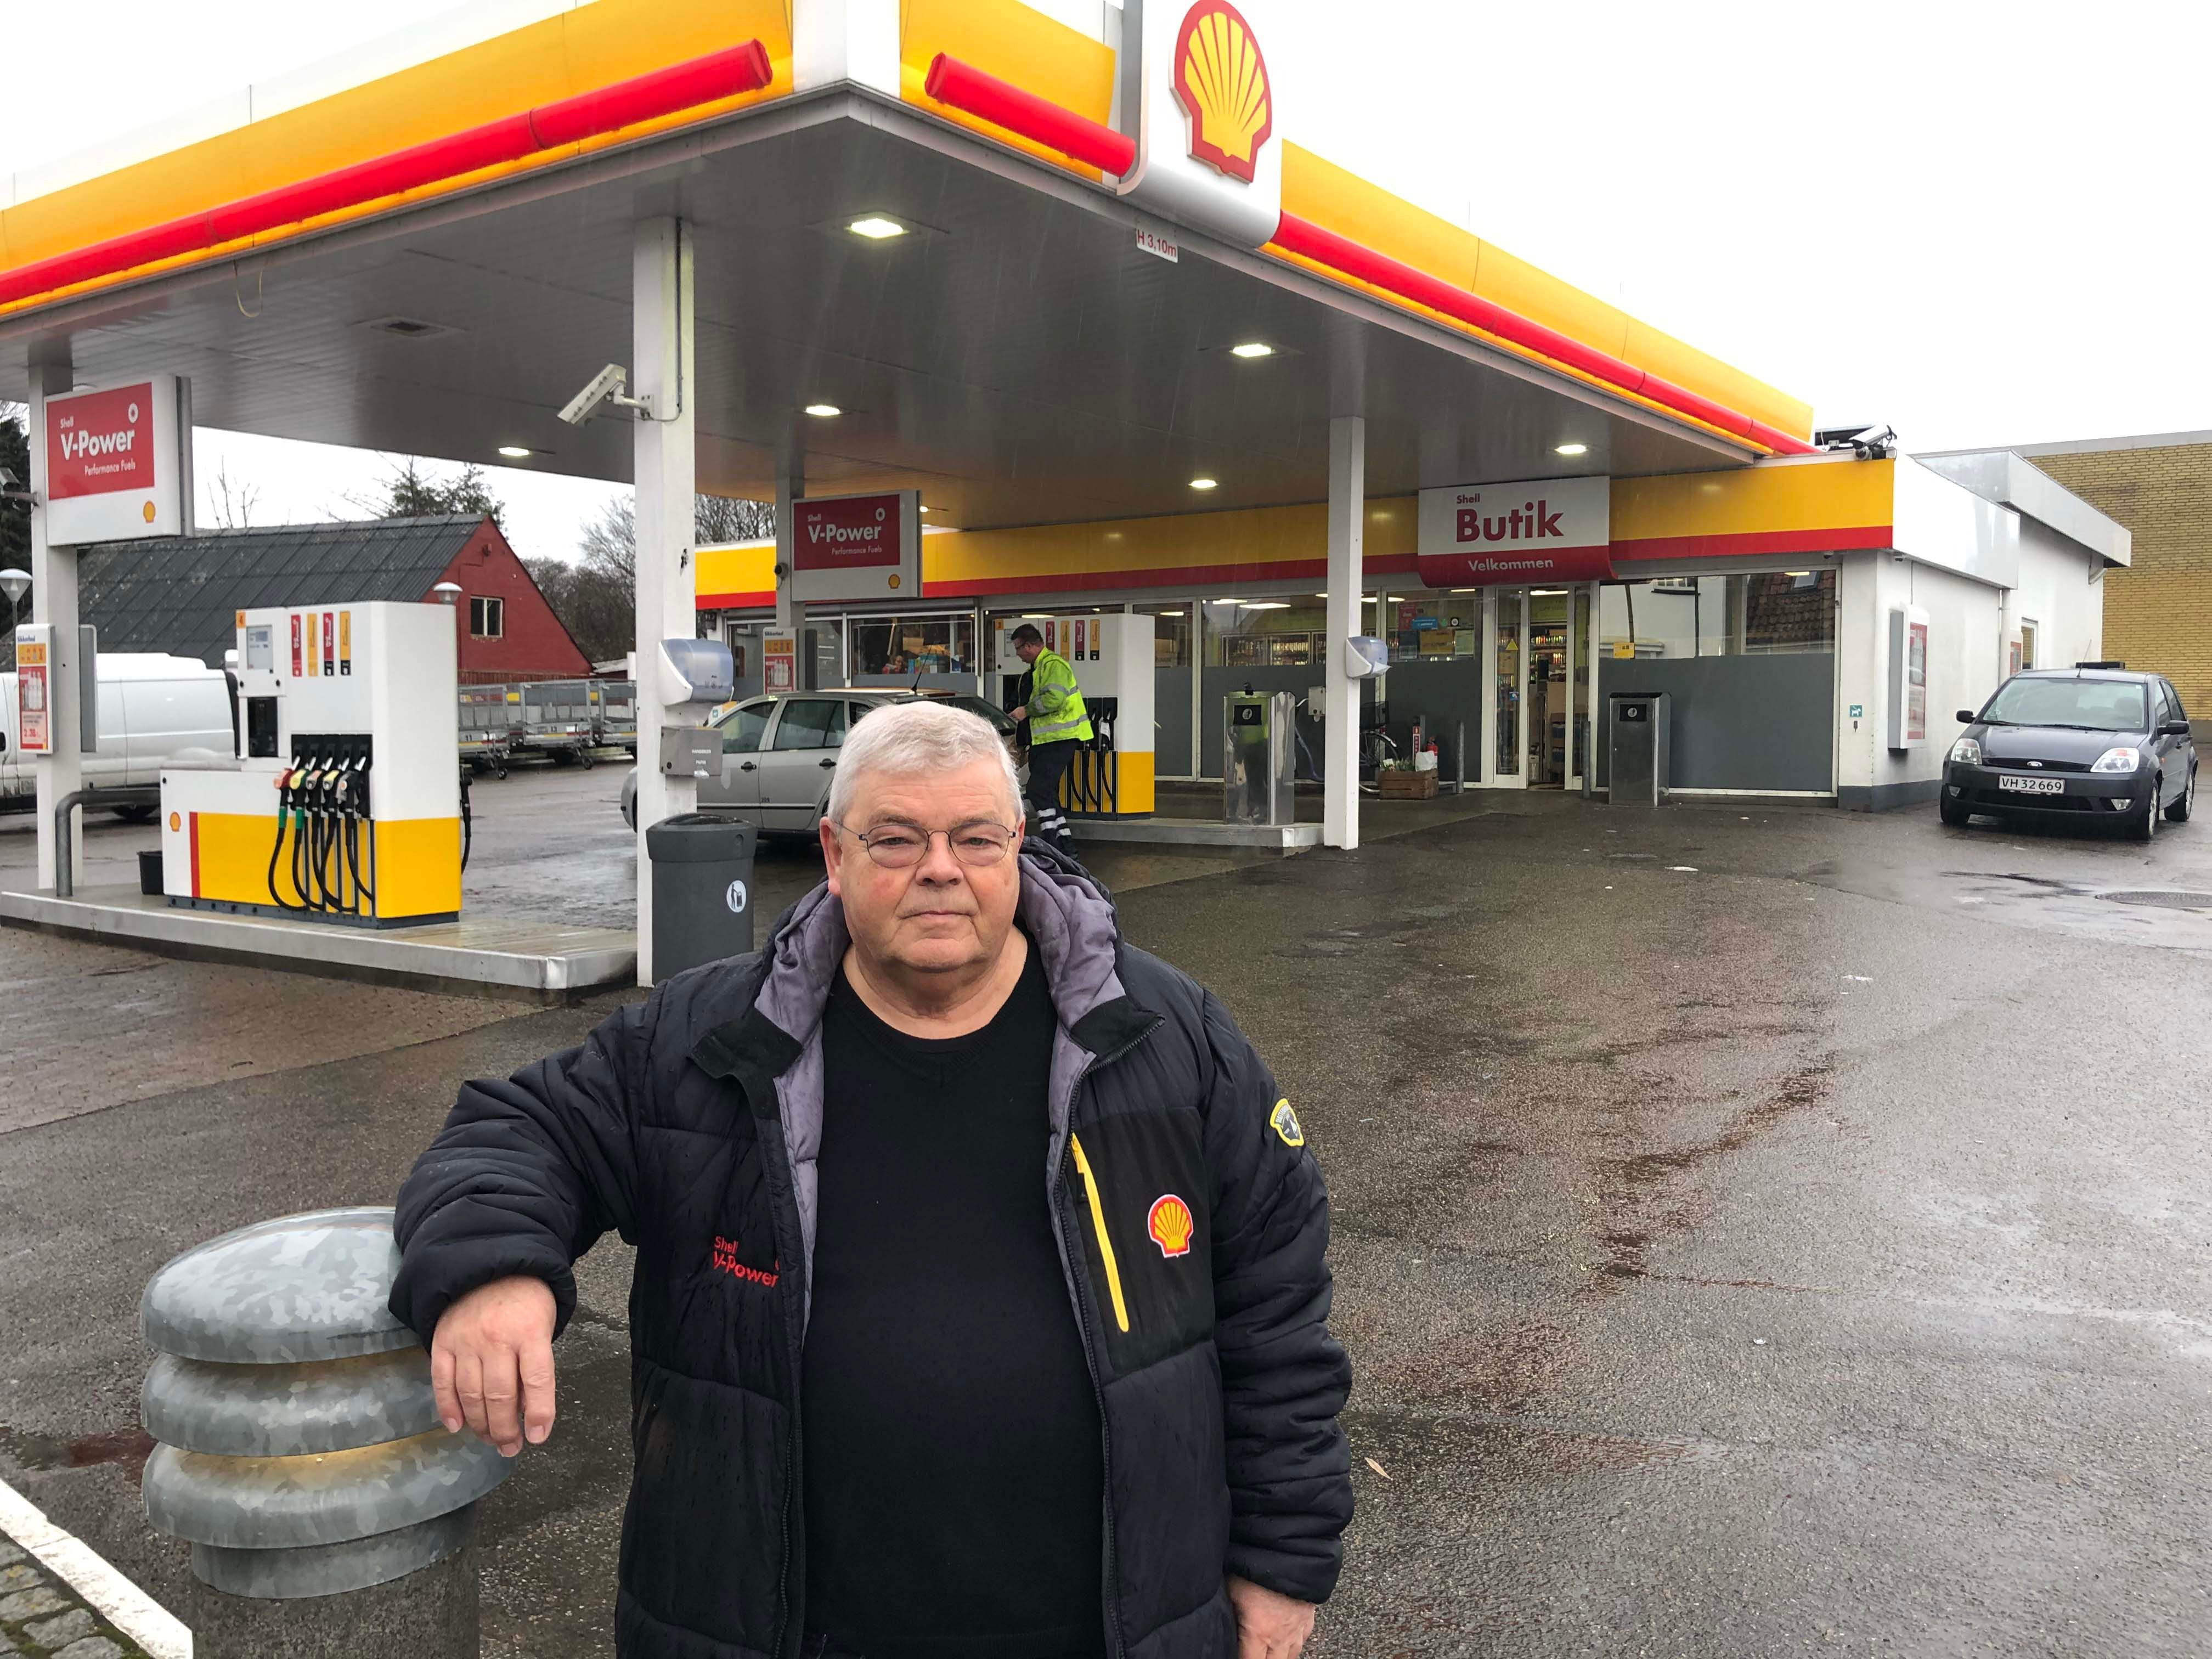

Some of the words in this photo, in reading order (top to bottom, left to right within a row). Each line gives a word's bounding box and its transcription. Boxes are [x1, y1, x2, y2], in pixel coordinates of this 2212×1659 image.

[1137, 229, 1145, 245] H
[1148, 234, 1177, 257] 3,10m
[60, 415, 74, 429] Shell
[60, 430, 136, 461] V-Power
[84, 463, 120, 477] Performance
[121, 458, 136, 472] Fuels
[1457, 493, 1480, 504] Shell
[807, 514, 822, 522] Shell
[1456, 500, 1564, 543] Butik
[807, 523, 882, 544] V-Power
[831, 546, 866, 556] Performance
[867, 544, 882, 554] Fuels
[1468, 558, 1554, 572] Velkommen
[2002, 777, 2018, 788] VH
[714, 1235, 739, 1255] Shell
[713, 1250, 779, 1288] V-Power
